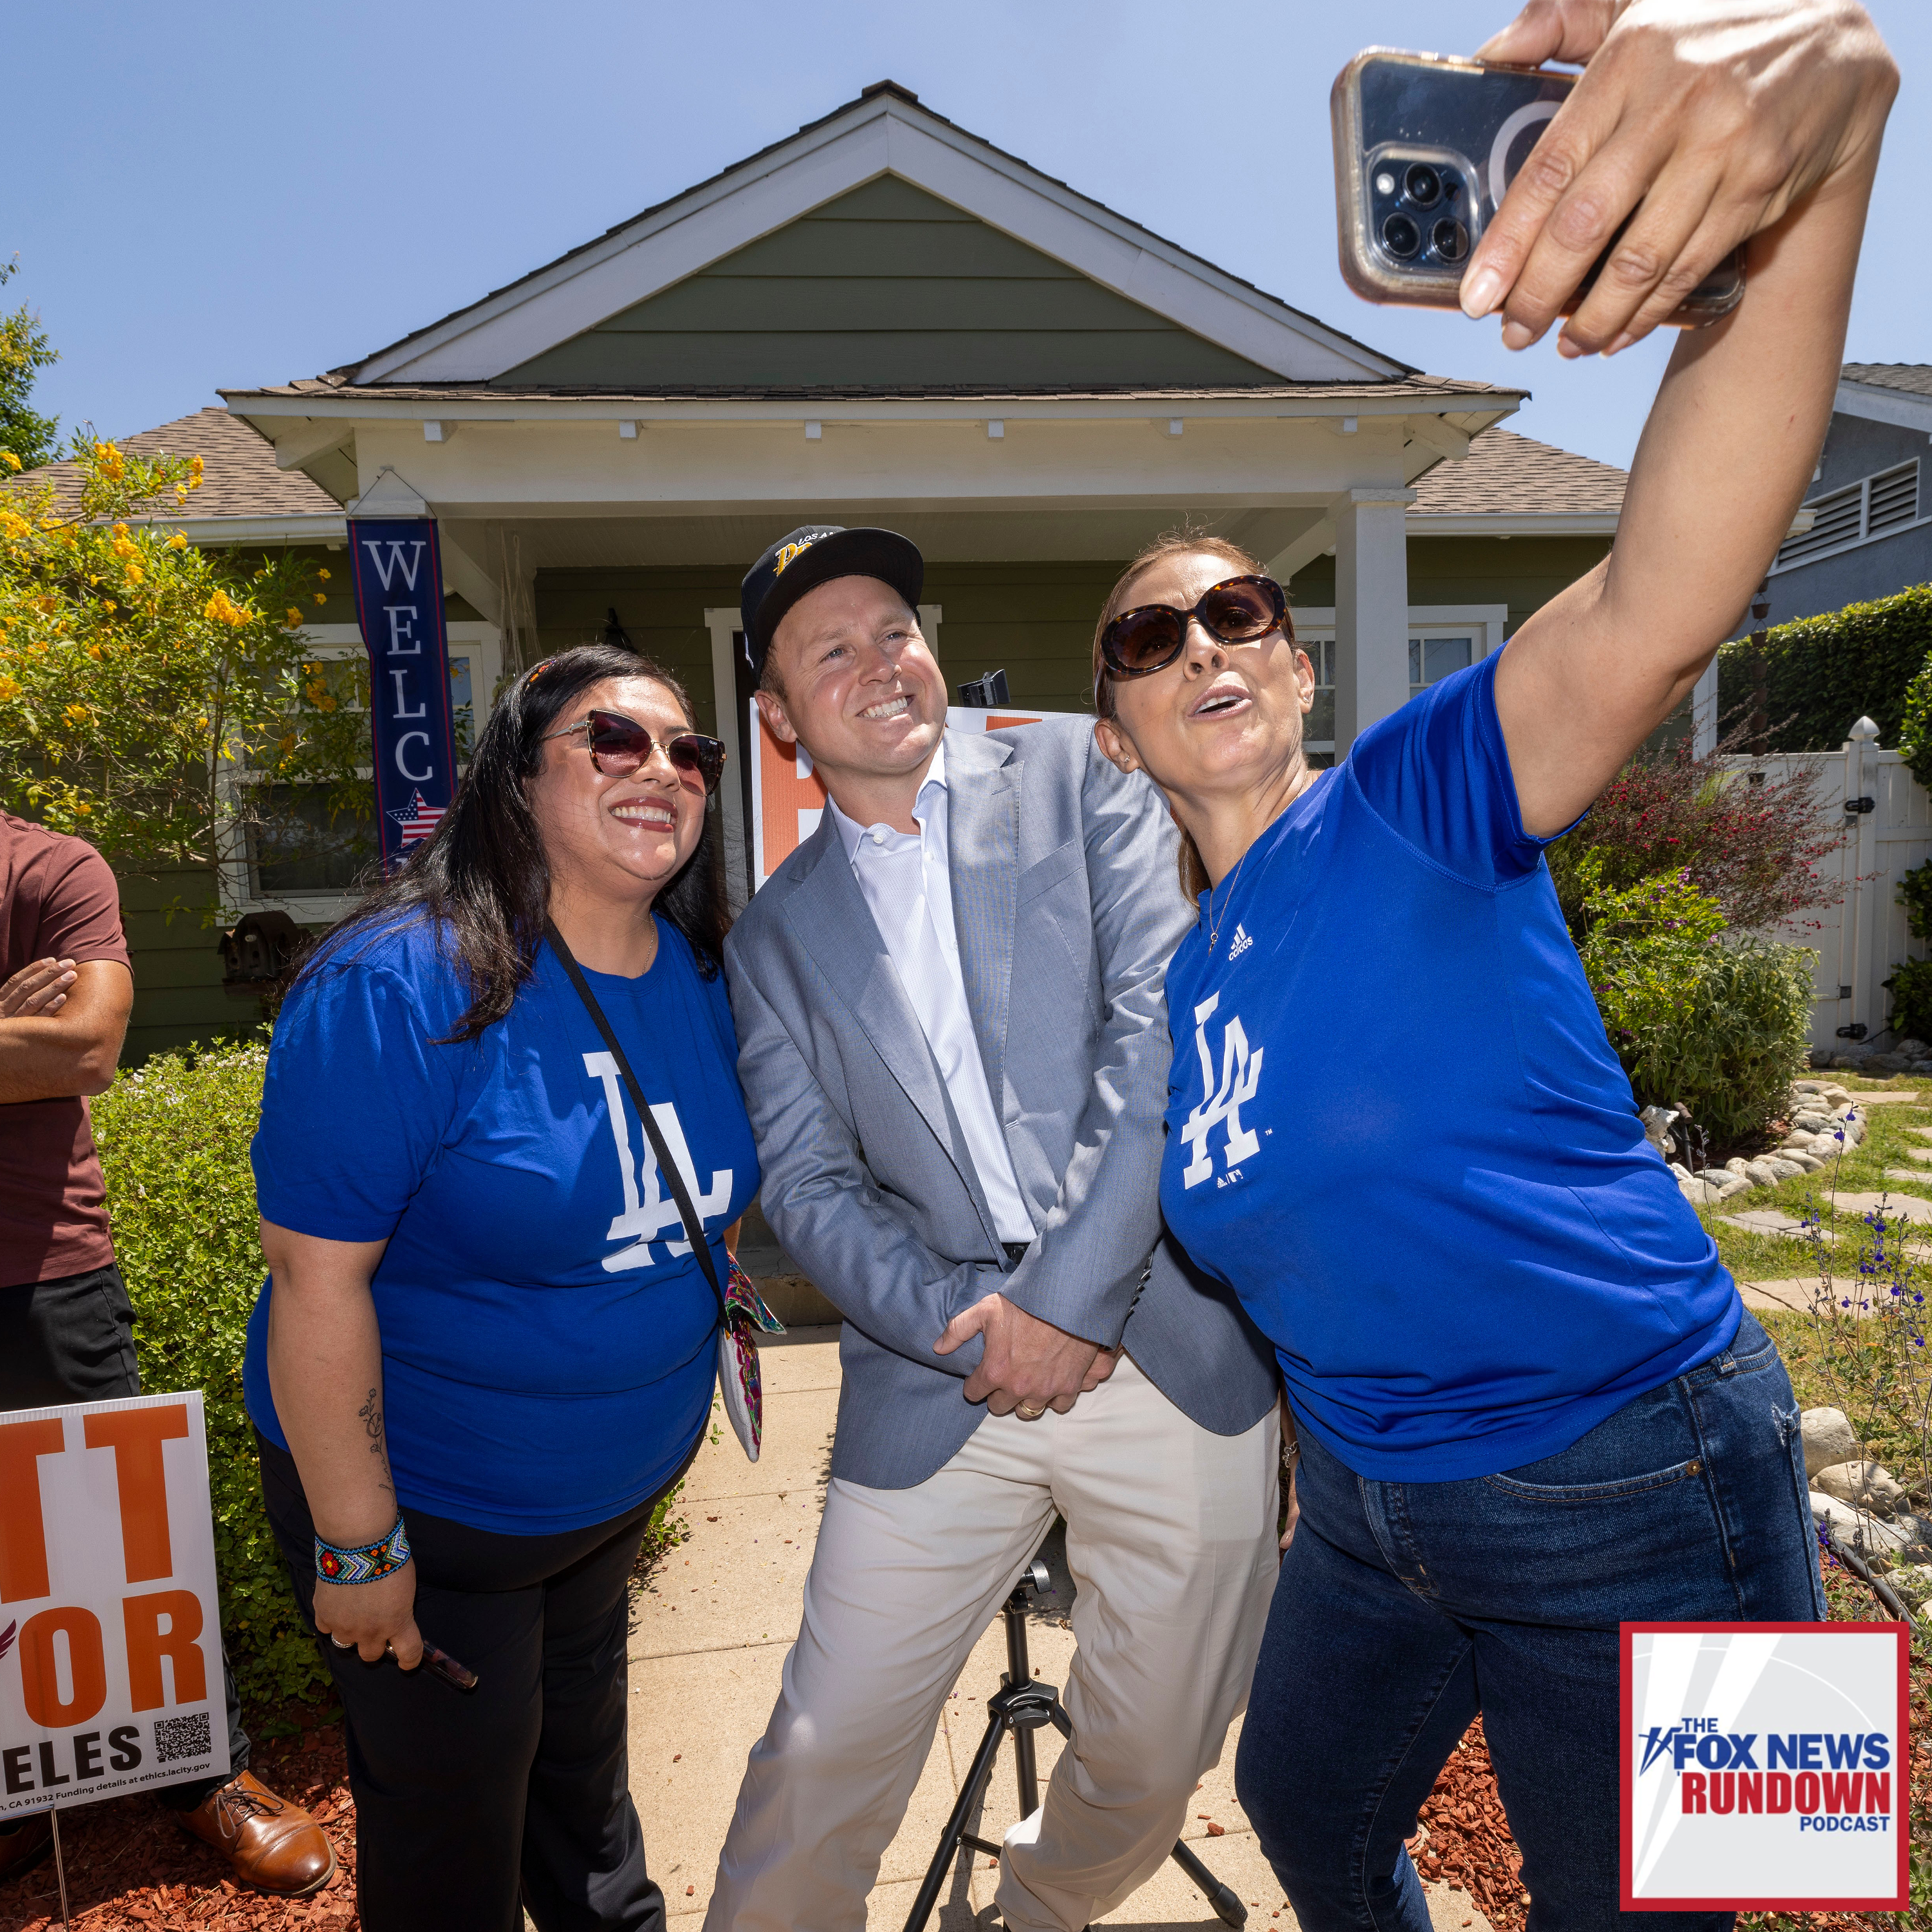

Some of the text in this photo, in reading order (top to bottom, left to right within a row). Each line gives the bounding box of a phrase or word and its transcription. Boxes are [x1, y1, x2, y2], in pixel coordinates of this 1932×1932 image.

[798, 533, 818, 545] LOS
[362, 540, 433, 866] WELC
[1229, 936, 1253, 961] adidas
[1180, 990, 1264, 1189] LA
[582, 1051, 733, 1273] LA
[19, 1589, 207, 1728] OR
[3, 1725, 142, 1795] ELES
[24, 1794, 53, 1806] 91932
[55, 1788, 94, 1799] Funding
[96, 1779, 127, 1791] details
[140, 1763, 210, 1781] ethics.lacity.gov
